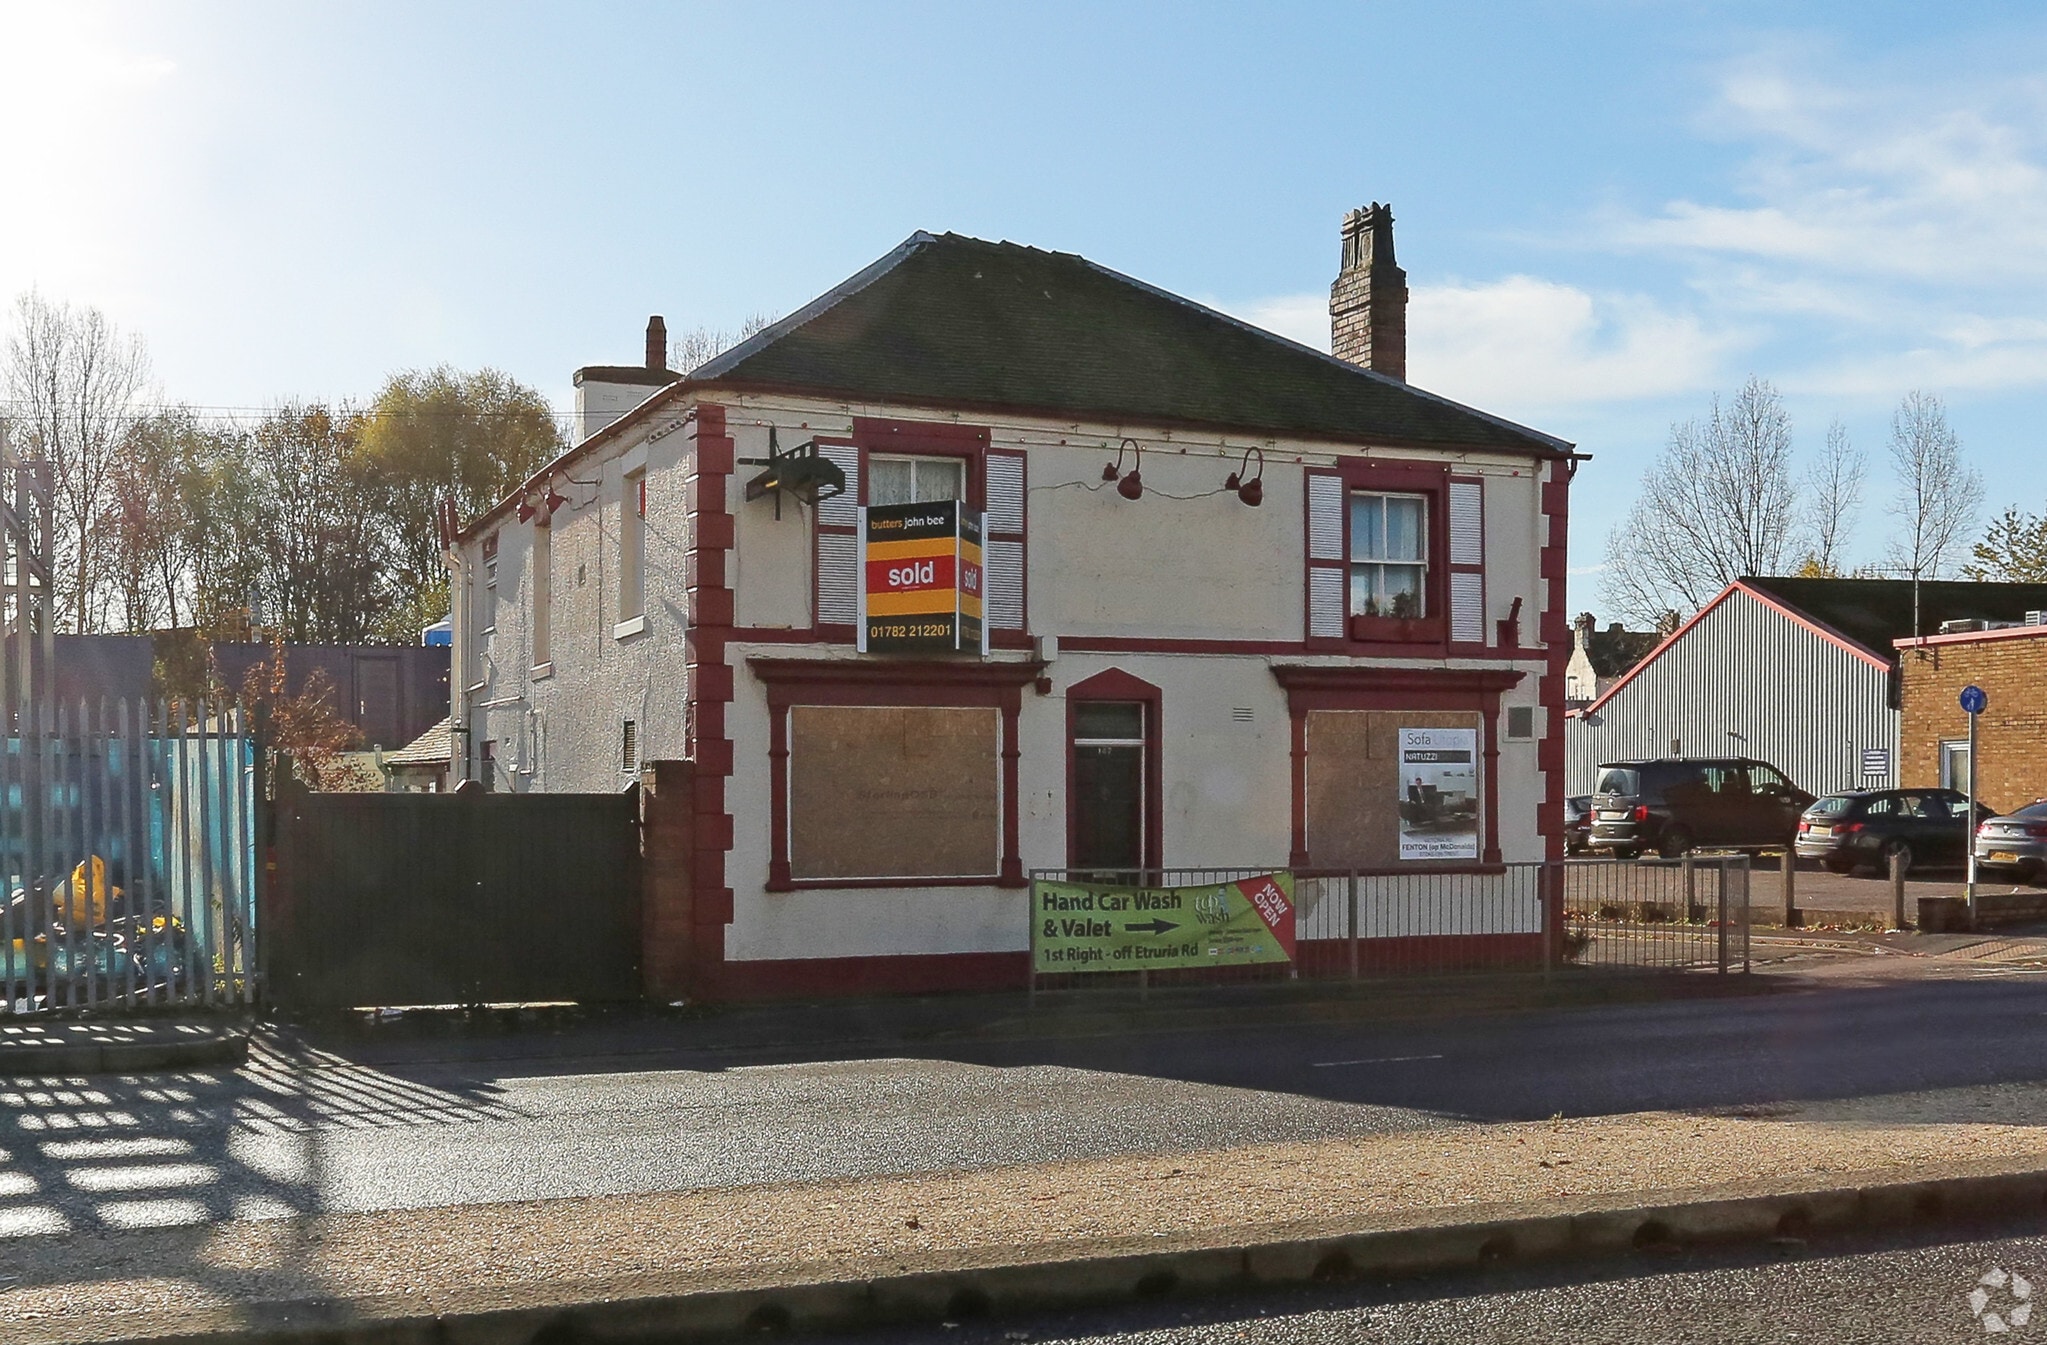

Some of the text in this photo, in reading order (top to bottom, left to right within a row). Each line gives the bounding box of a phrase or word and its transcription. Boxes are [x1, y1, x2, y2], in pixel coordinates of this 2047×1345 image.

[871, 515, 945, 530] butters john bee
[888, 560, 934, 587] sold
[870, 625, 906, 638] 01782
[908, 624, 951, 637] 212201
[1407, 732, 1431, 746] Sofa
[1405, 752, 1438, 761] NATUZZI
[1402, 843, 1428, 851] FENTON
[1043, 890, 1182, 911] Hand Car Wash
[1262, 883, 1288, 915] NOW
[1254, 893, 1280, 927] OPEN
[1043, 918, 1112, 938] & Valet
[1044, 949, 1063, 961] 1st
[1066, 947, 1103, 963] Right
[1113, 946, 1132, 960] off
[1135, 944, 1179, 959] Etruria
[1181, 942, 1199, 957] Rd
